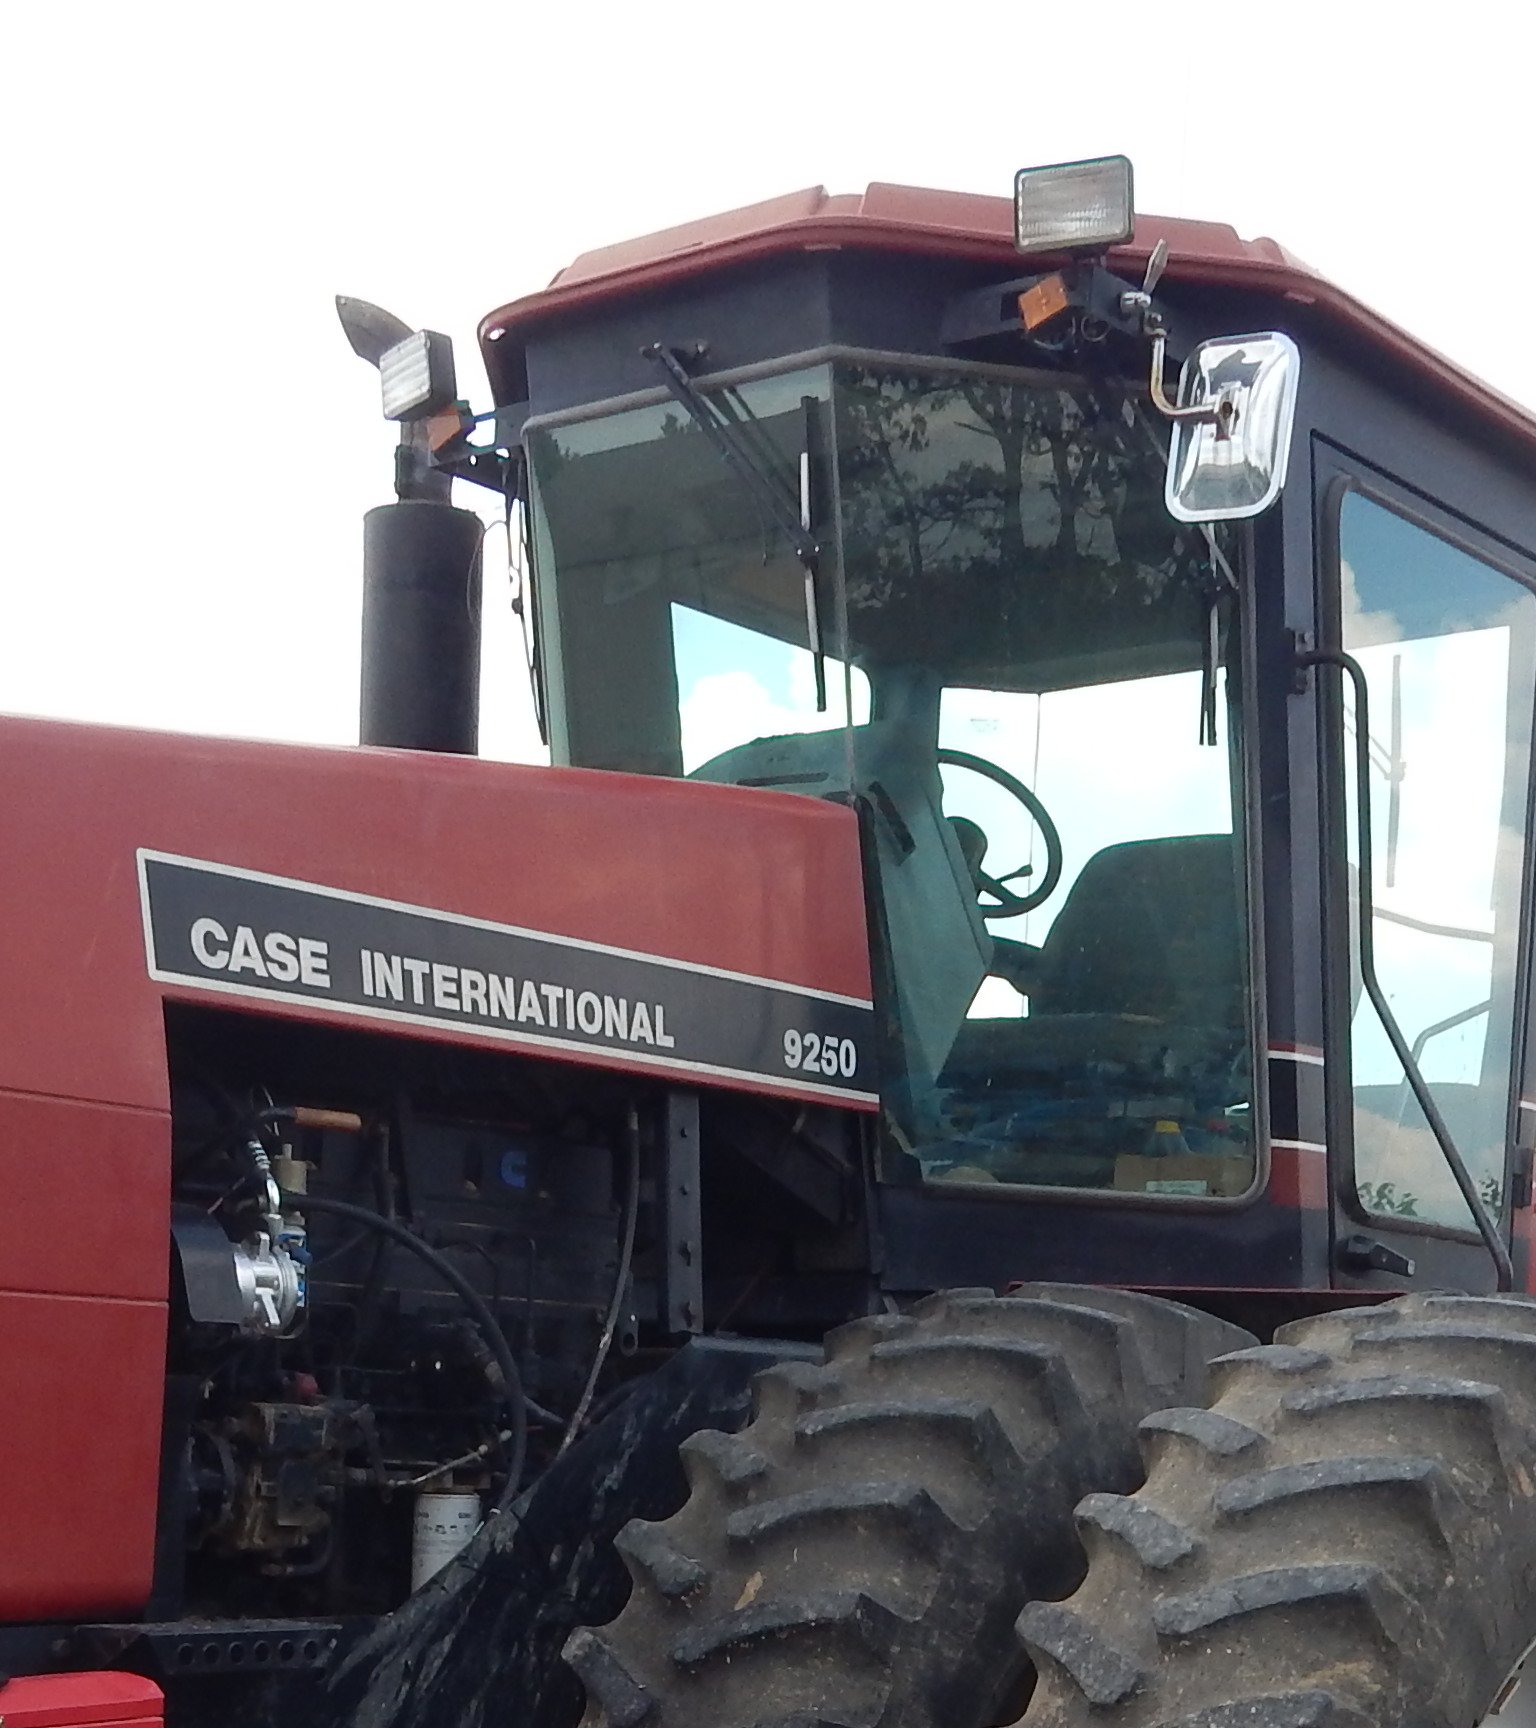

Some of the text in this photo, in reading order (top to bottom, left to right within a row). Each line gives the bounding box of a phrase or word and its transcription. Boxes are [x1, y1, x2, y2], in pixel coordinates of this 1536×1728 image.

[190, 916, 676, 1048] CASE INTERNATIONAL
[783, 1028, 857, 1078] 9250
